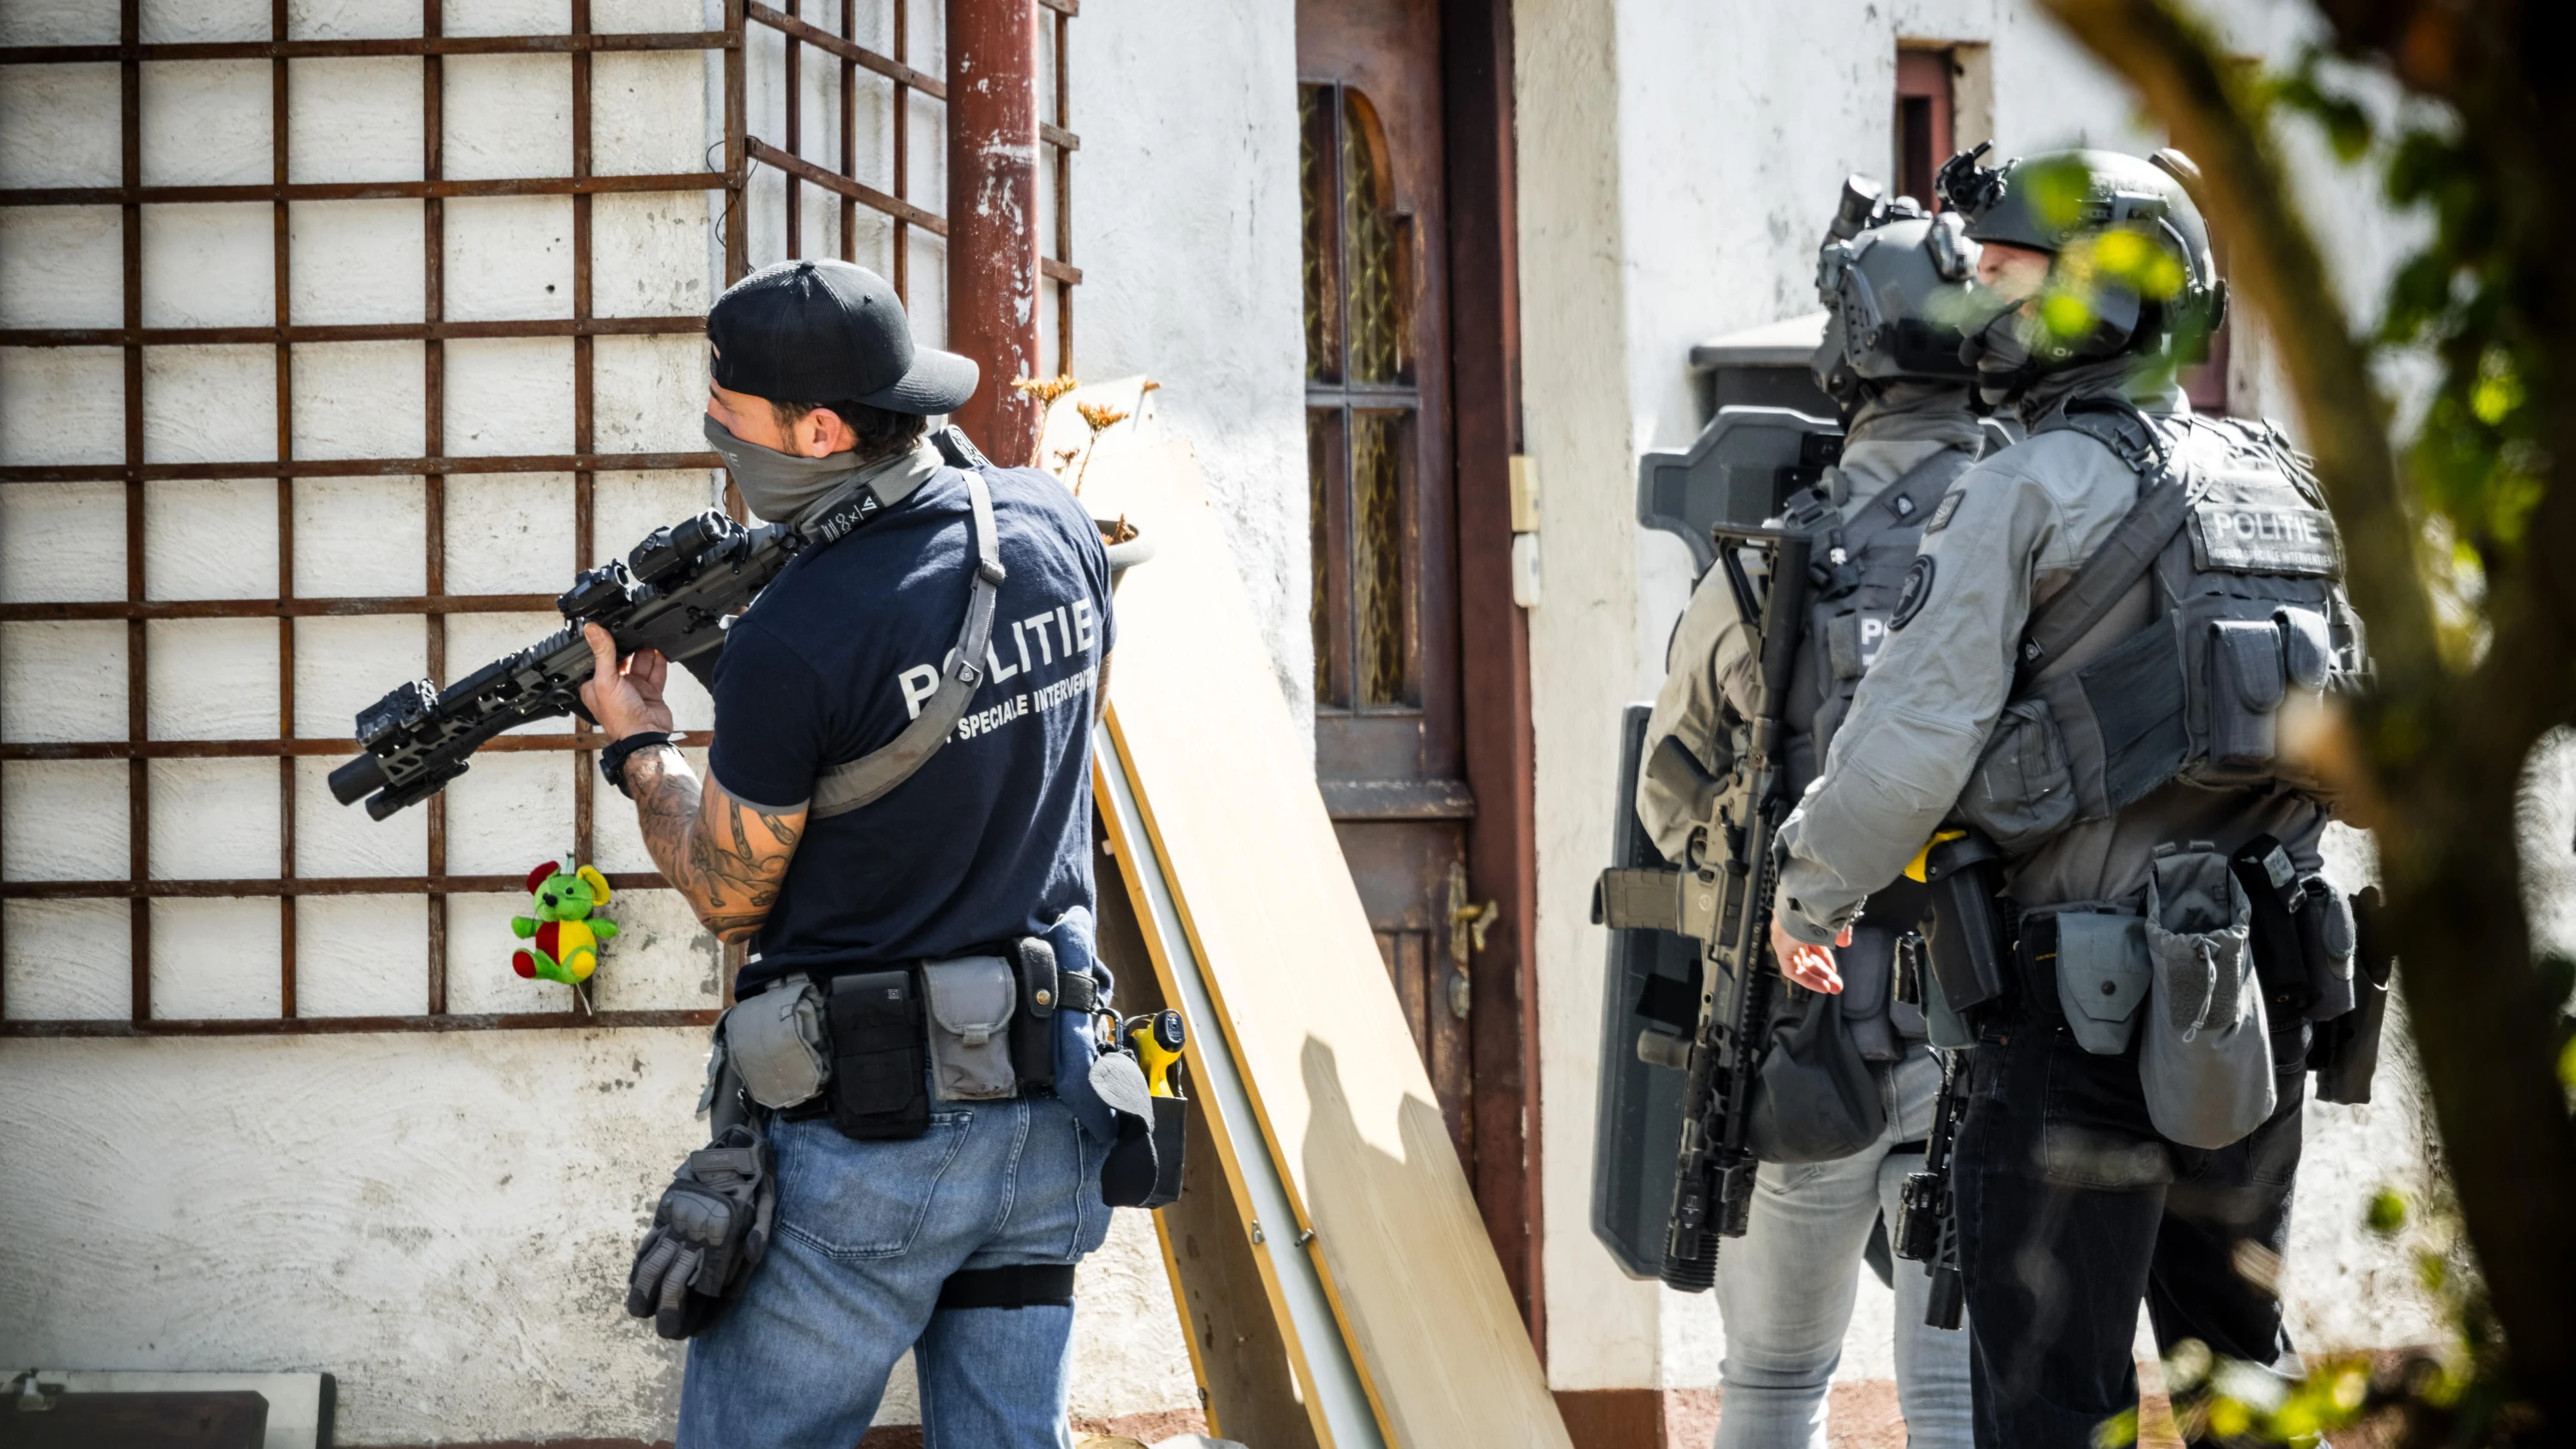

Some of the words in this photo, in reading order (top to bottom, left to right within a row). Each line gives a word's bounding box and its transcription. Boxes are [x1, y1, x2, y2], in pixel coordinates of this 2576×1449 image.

[2213, 512, 2322, 544] POLITIE
[898, 598, 1095, 720] PLITIE
[958, 694, 1029, 740] SPECIALE
